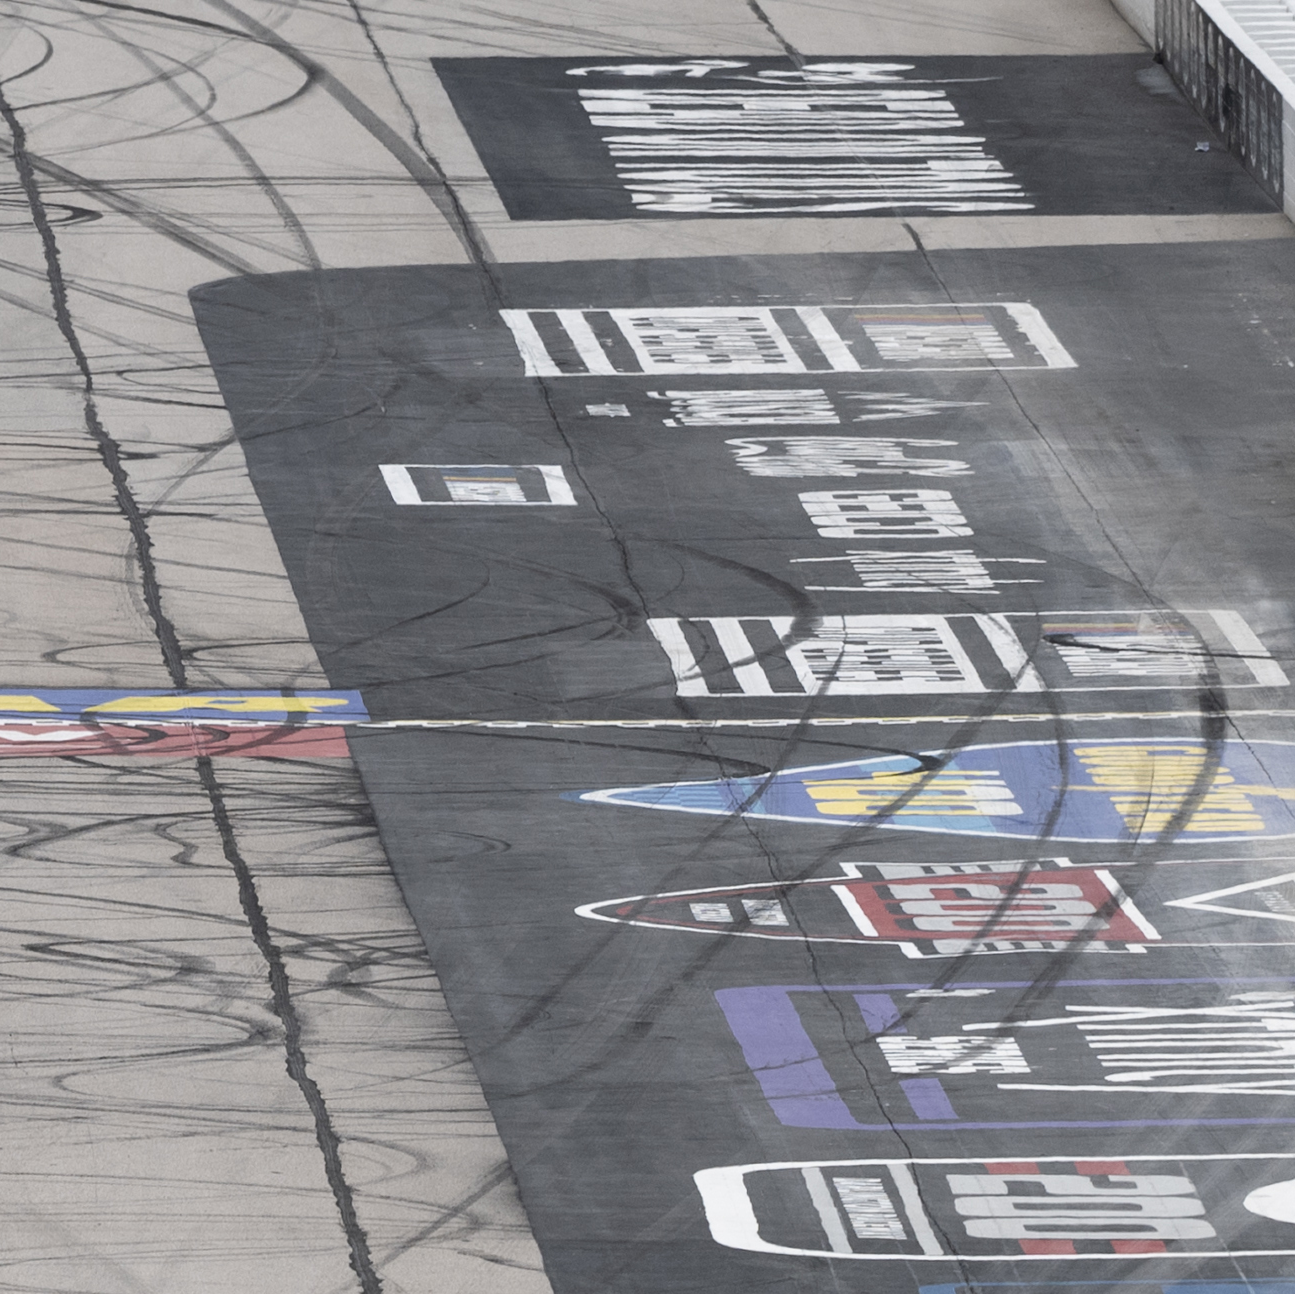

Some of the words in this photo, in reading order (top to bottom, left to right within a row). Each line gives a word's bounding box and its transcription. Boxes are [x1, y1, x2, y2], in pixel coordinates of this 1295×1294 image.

[578, 88, 965, 130] DEAD
[615, 159, 1035, 213] TOOLS
[639, 334, 788, 364] SERIES
[646, 389, 841, 426] BUSCH
[798, 489, 975, 538] GEICO
[789, 549, 1047, 595] xfinity
[802, 769, 1024, 816] 400
[1073, 745, 1267, 834] GOODYEAR
[888, 882, 1111, 932] 200
[876, 1036, 1031, 1074] SERIES
[946, 1174, 1217, 1240] 200
